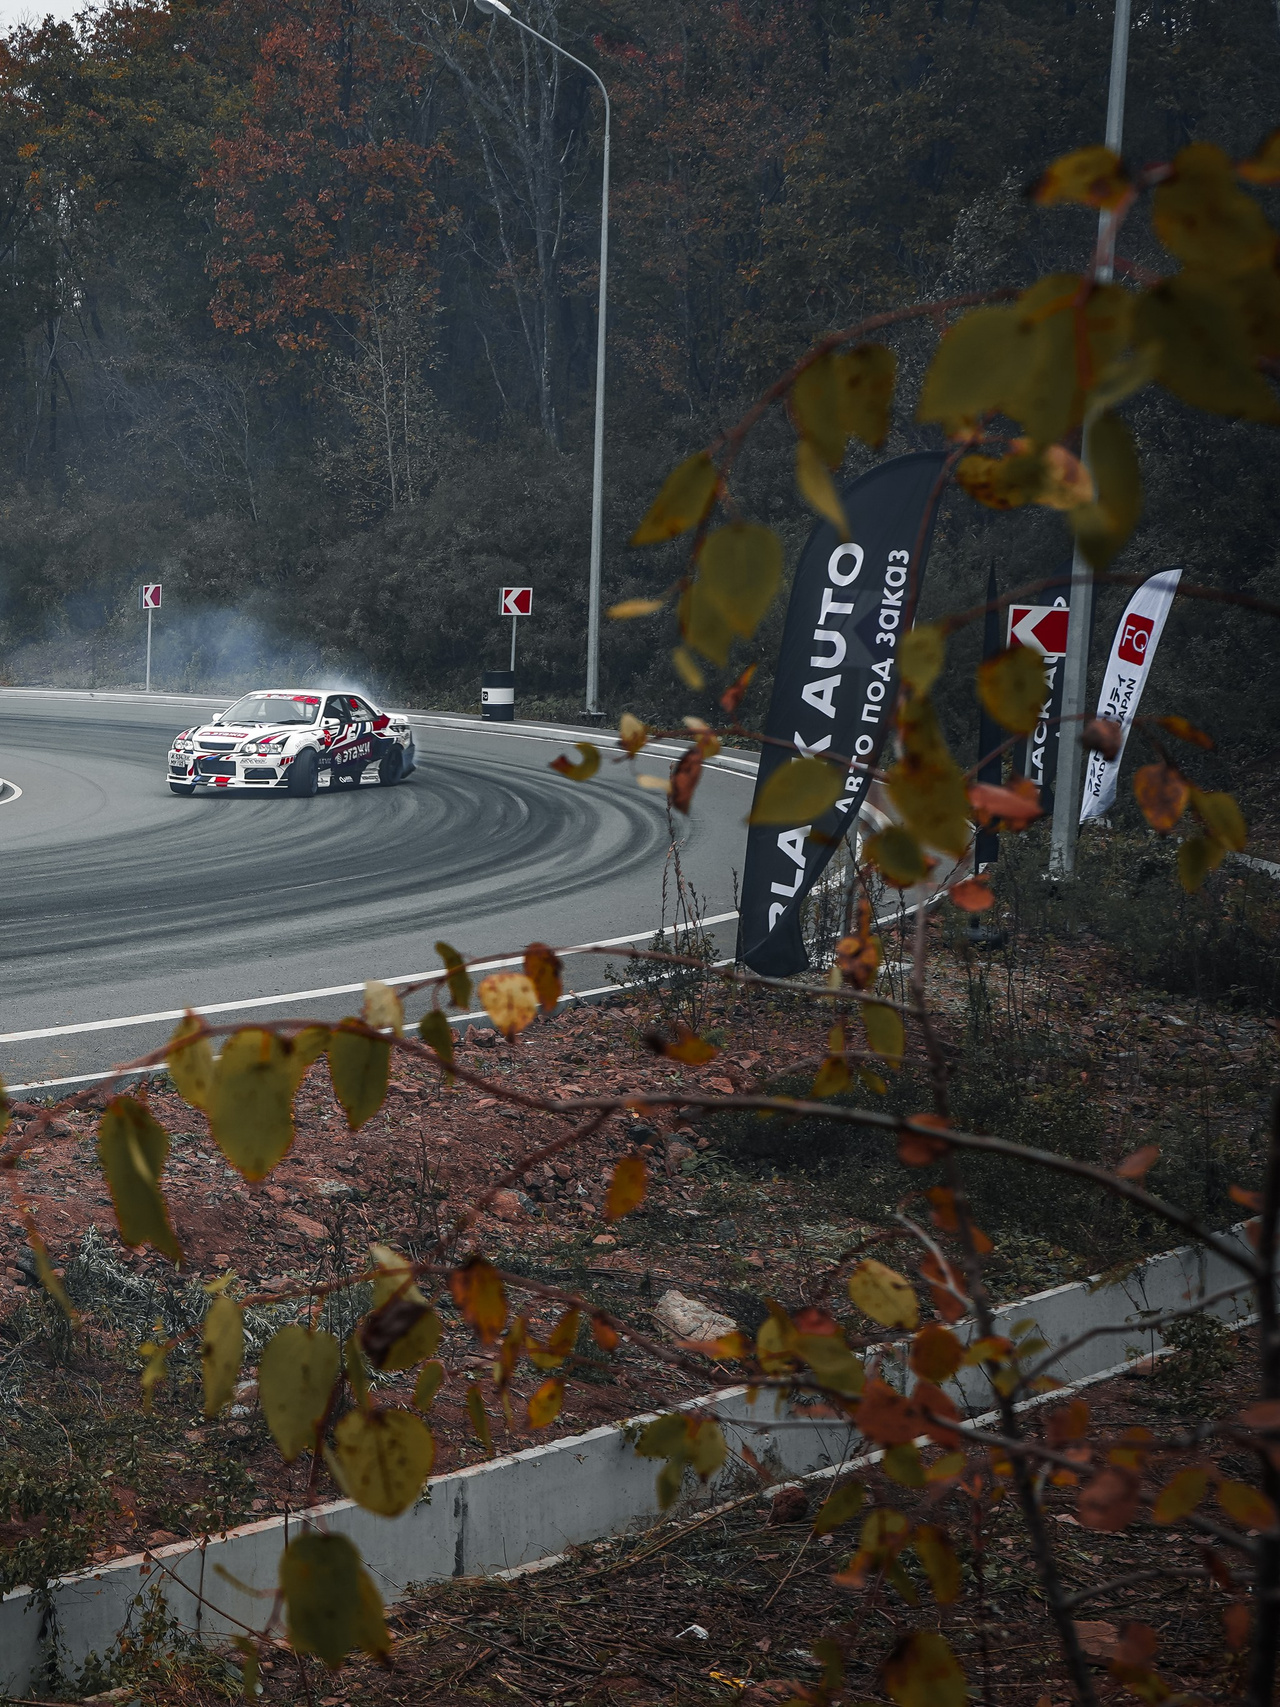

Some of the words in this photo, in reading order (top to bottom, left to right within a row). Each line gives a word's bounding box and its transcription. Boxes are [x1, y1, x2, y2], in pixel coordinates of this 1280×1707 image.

[875, 549, 910, 647] заказ
[1122, 625, 1149, 653] FQ
[861, 658, 895, 723] под
[768, 731, 832, 932] LAK
[801, 543, 864, 719] AUTO
[1031, 698, 1053, 794] LACK
[1093, 755, 1108, 797] MAD
